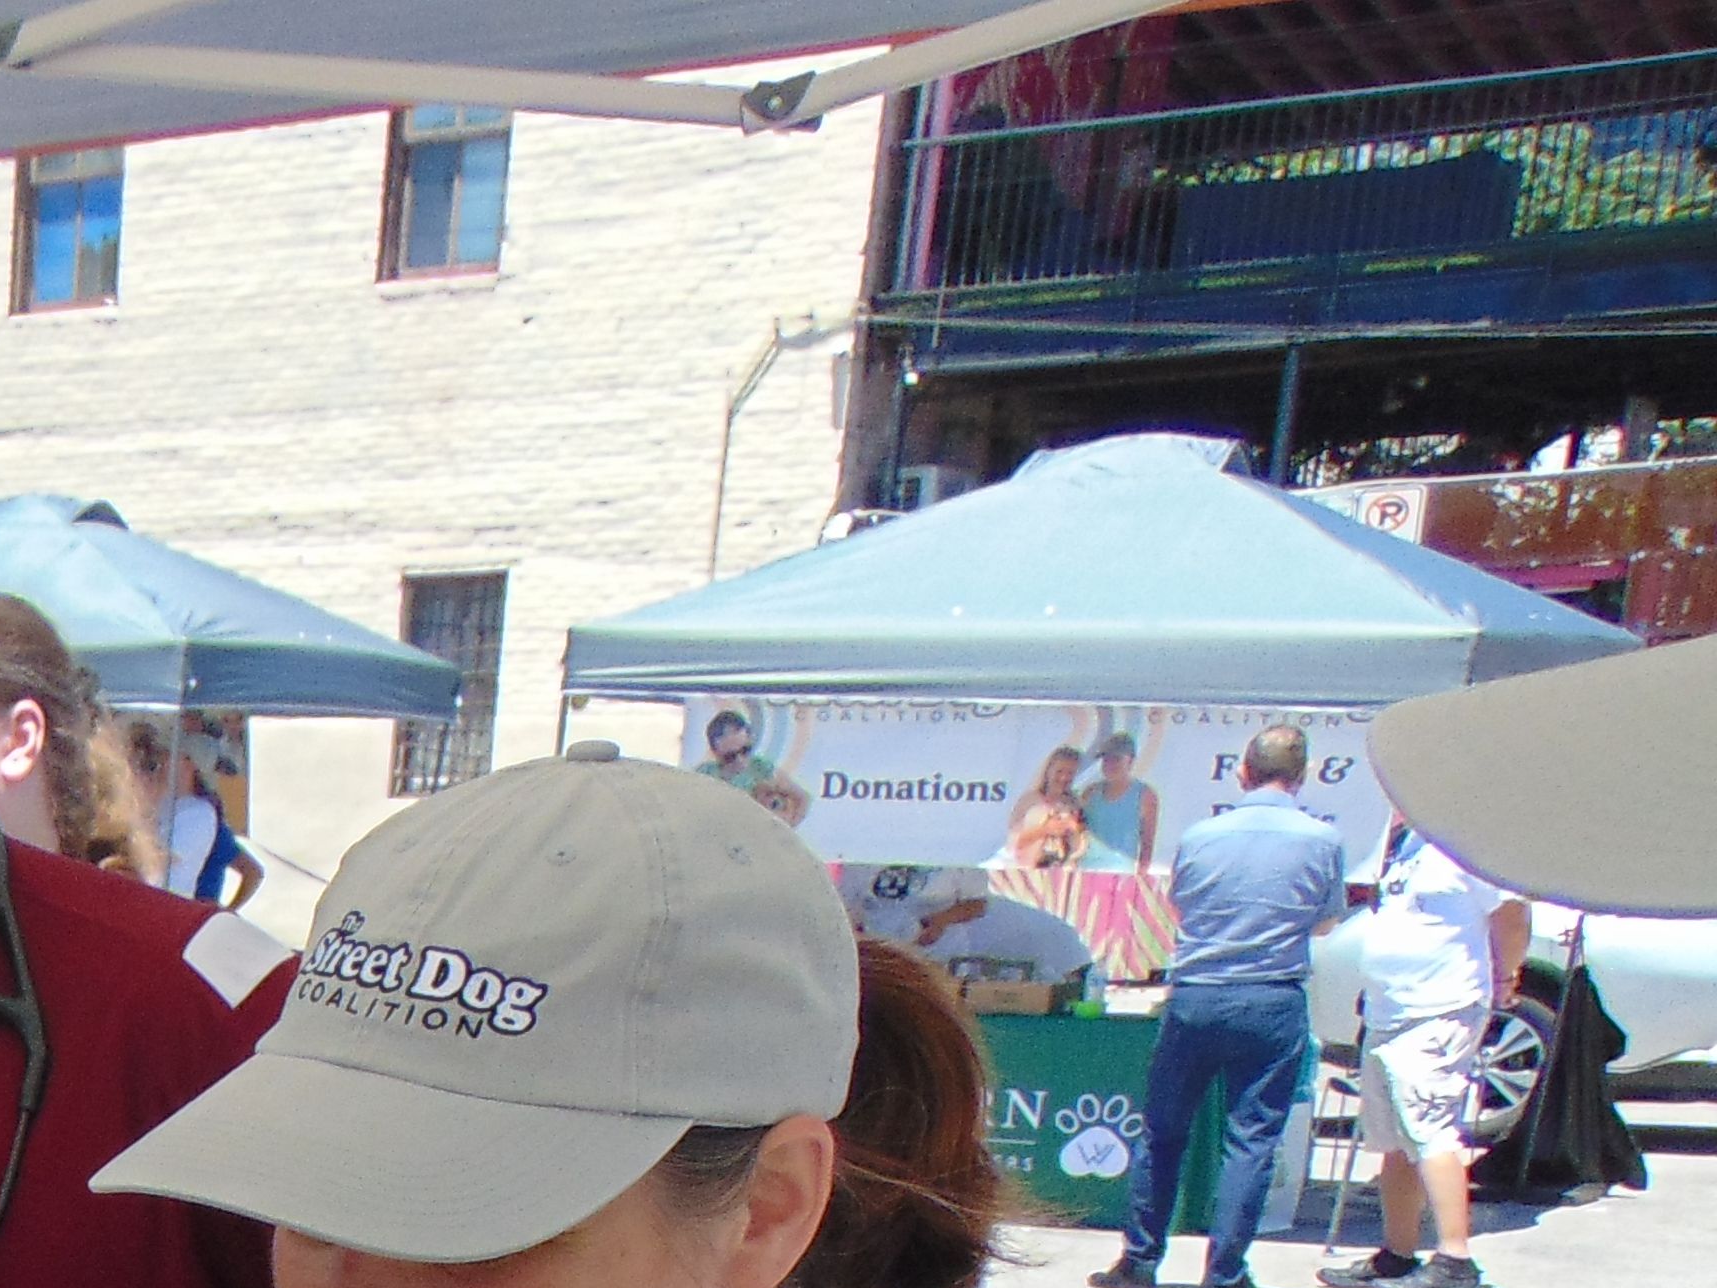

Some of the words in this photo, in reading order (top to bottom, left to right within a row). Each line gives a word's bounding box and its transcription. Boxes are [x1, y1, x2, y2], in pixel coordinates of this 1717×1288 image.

[793, 706, 968, 724] COALITION
[820, 769, 1008, 803] Donations
[1317, 756, 1354, 785] &
[300, 927, 413, 993] Street
[405, 945, 549, 1036] Dog
[296, 977, 485, 1040] COALITION
